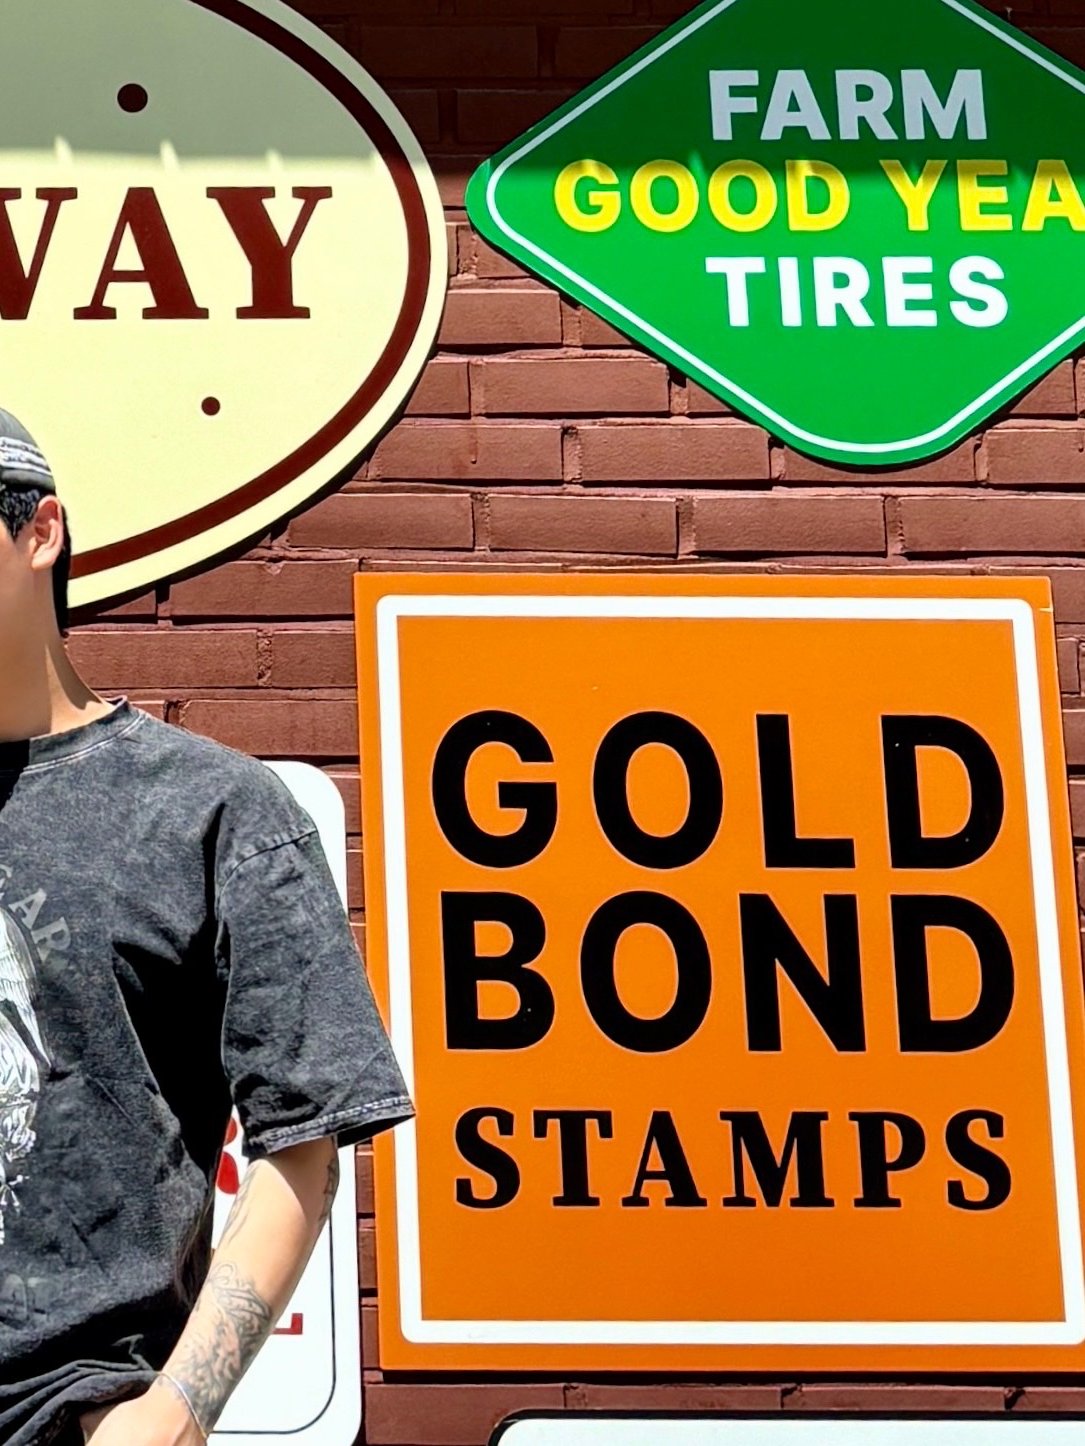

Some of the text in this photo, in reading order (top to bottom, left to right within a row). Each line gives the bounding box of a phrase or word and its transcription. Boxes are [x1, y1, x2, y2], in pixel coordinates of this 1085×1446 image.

[708, 69, 988, 141] FARM
[554, 159, 1085, 232] GOOD YEA
[705, 255, 1009, 328] TIRES
[431, 709, 1005, 870] GOLD
[440, 890, 1016, 1054] BOND
[454, 1106, 1013, 1211] STAMPS
